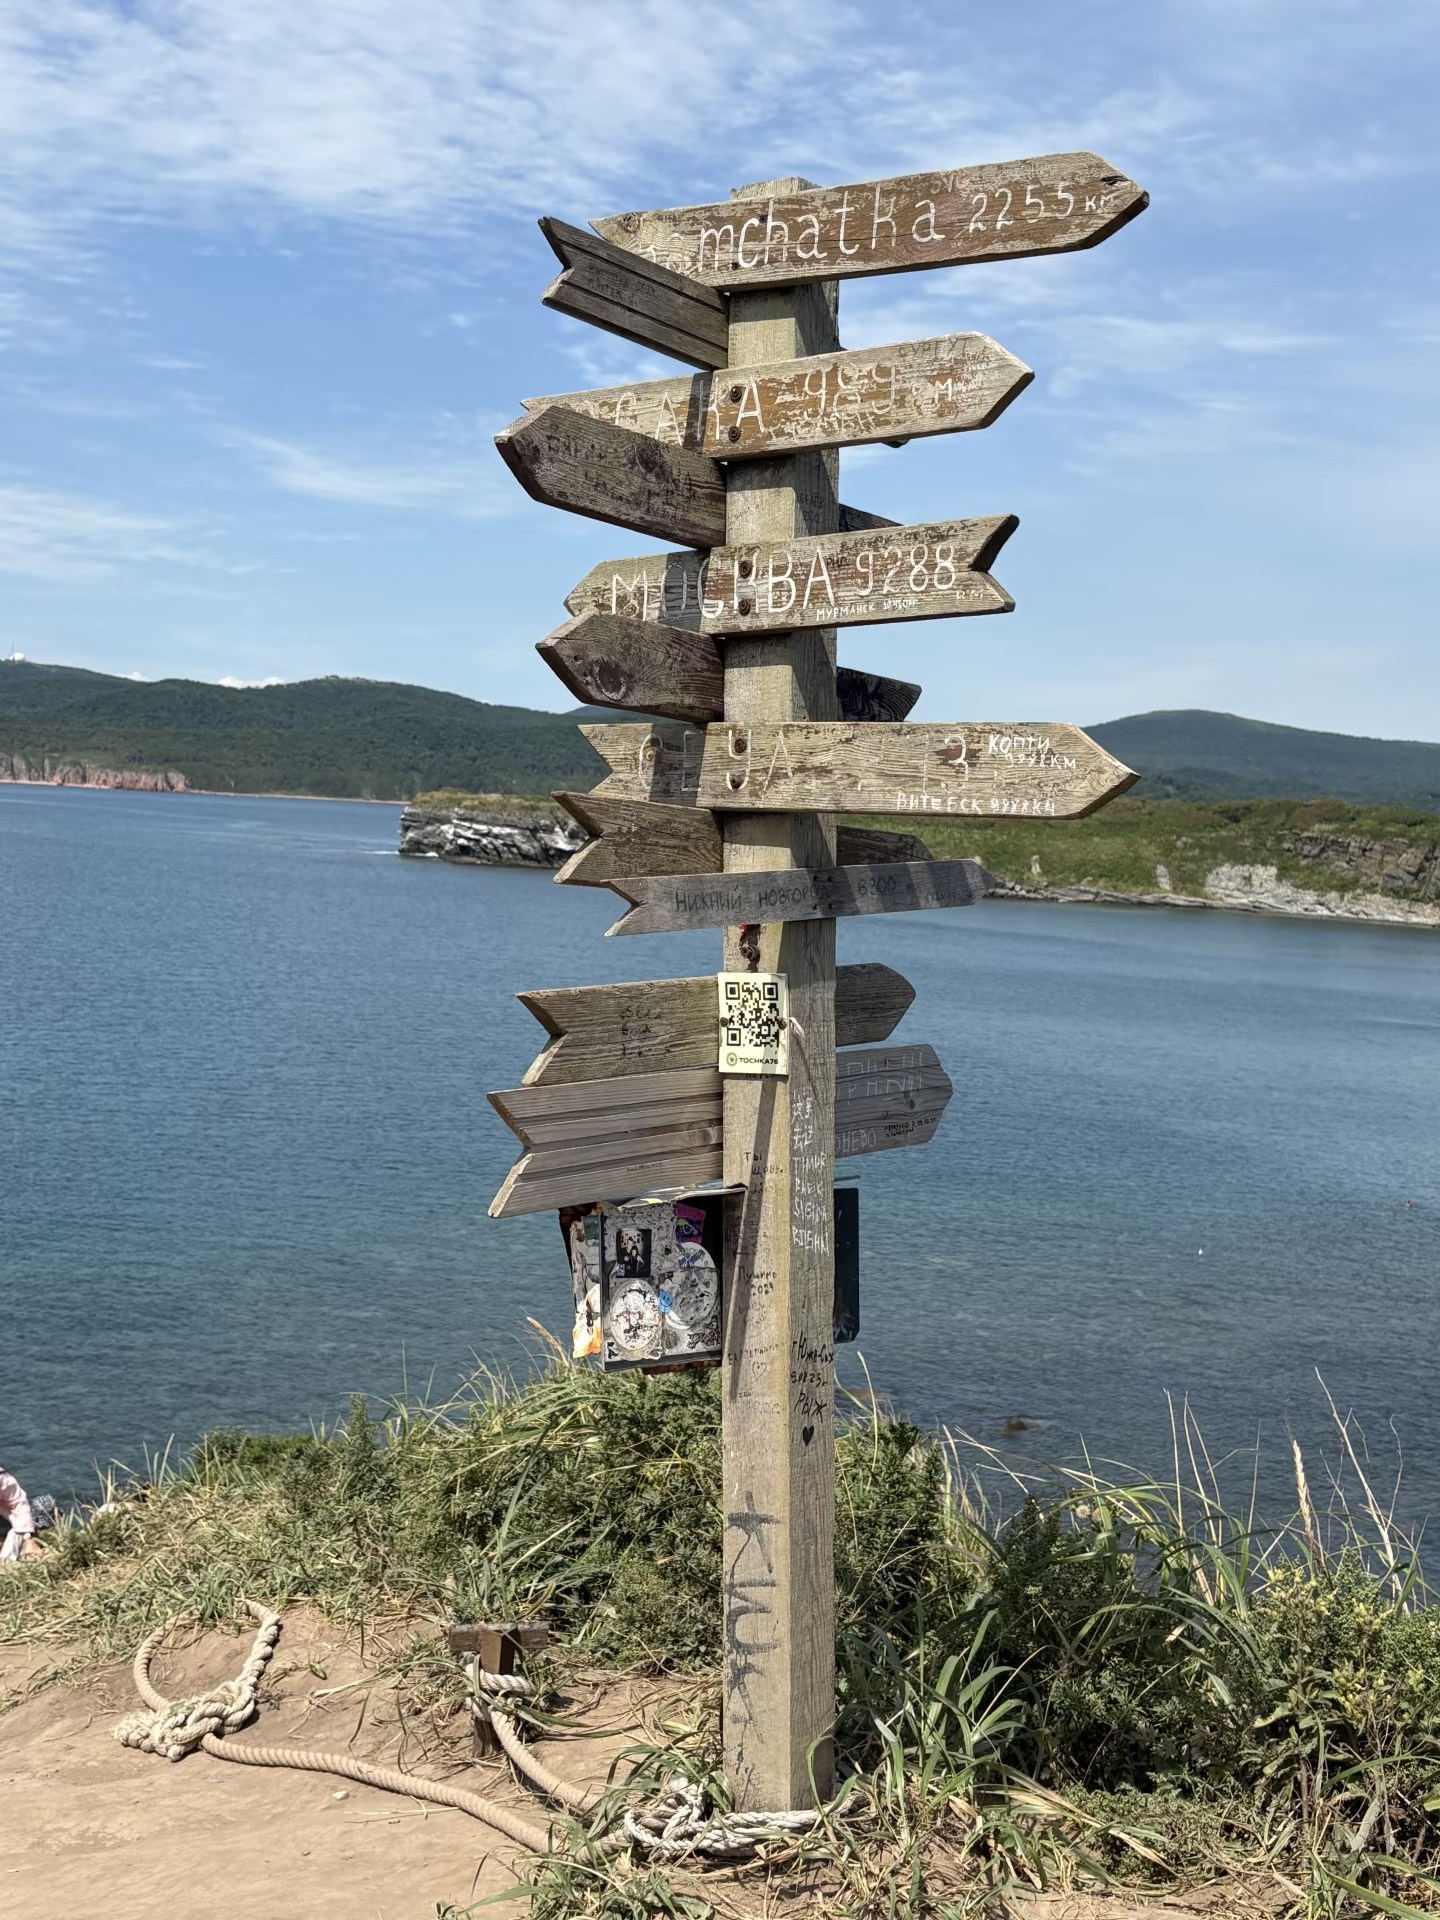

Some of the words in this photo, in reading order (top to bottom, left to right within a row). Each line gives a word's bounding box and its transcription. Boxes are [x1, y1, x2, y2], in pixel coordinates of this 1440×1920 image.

[968, 181, 1074, 234] 2255
[611, 545, 836, 622] МОСКВА
[856, 543, 956, 596] 9288
[816, 602, 875, 622] МУРМАНСК
[988, 734, 1050, 757] КОПТИ
[638, 729, 793, 803] СЕУЛ
[674, 884, 744, 913] НИЖНИЙ
[856, 876, 897, 897] 6300
[739, 1057, 779, 1065] TOCHKA76
